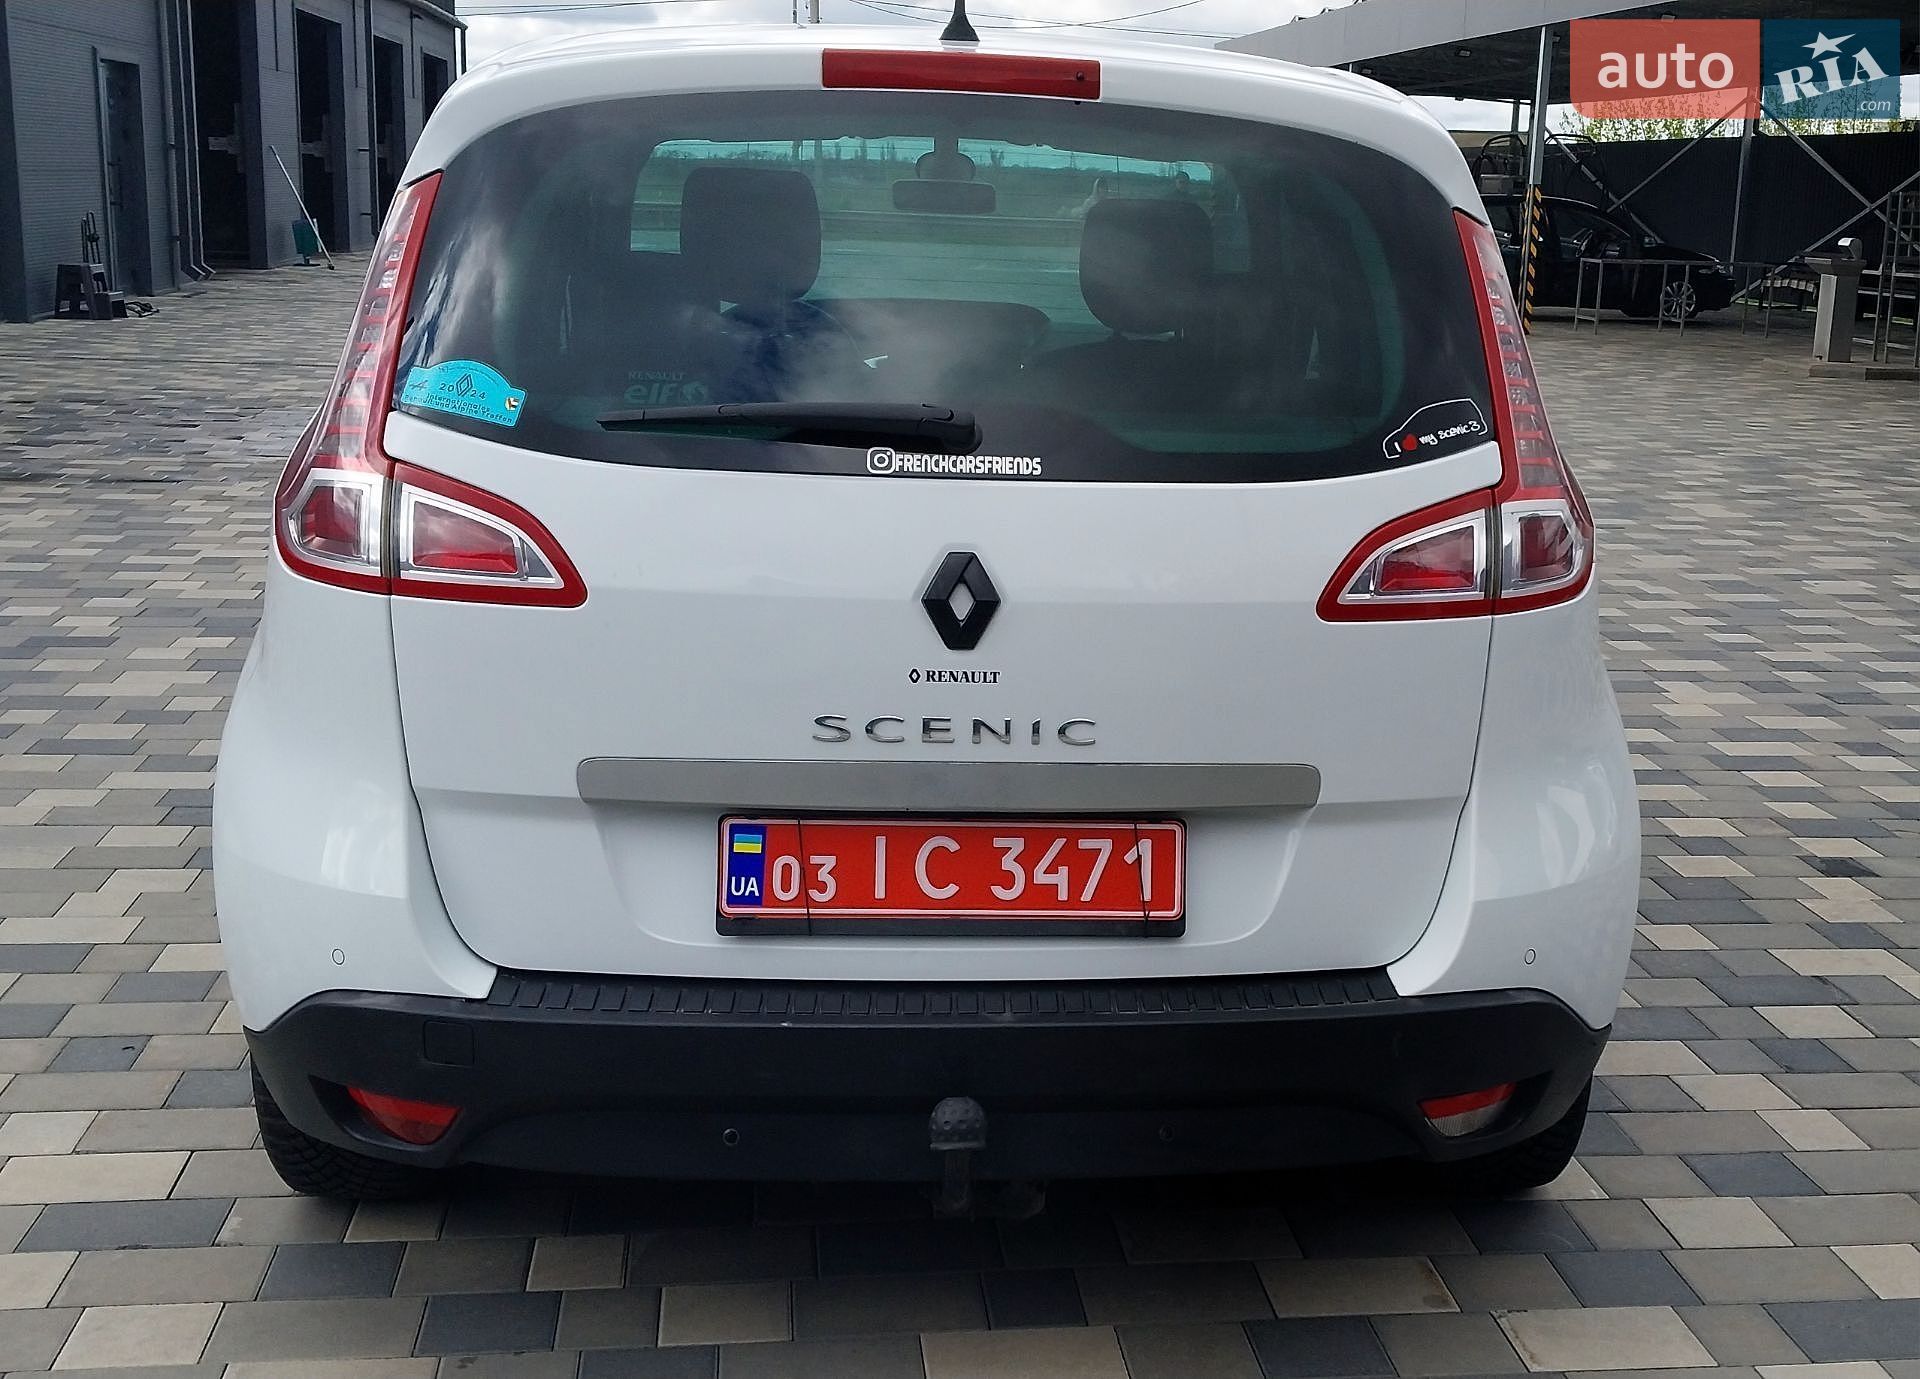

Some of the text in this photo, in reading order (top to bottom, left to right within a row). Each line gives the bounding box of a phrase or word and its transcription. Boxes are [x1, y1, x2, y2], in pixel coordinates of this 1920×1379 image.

[895, 454, 1042, 476] FRENCHCARSFRIENDS
[925, 670, 1001, 684] RENAULT
[812, 715, 1096, 746] SCENIC
[990, 836, 1153, 903] 3471
[730, 876, 760, 897] UA
